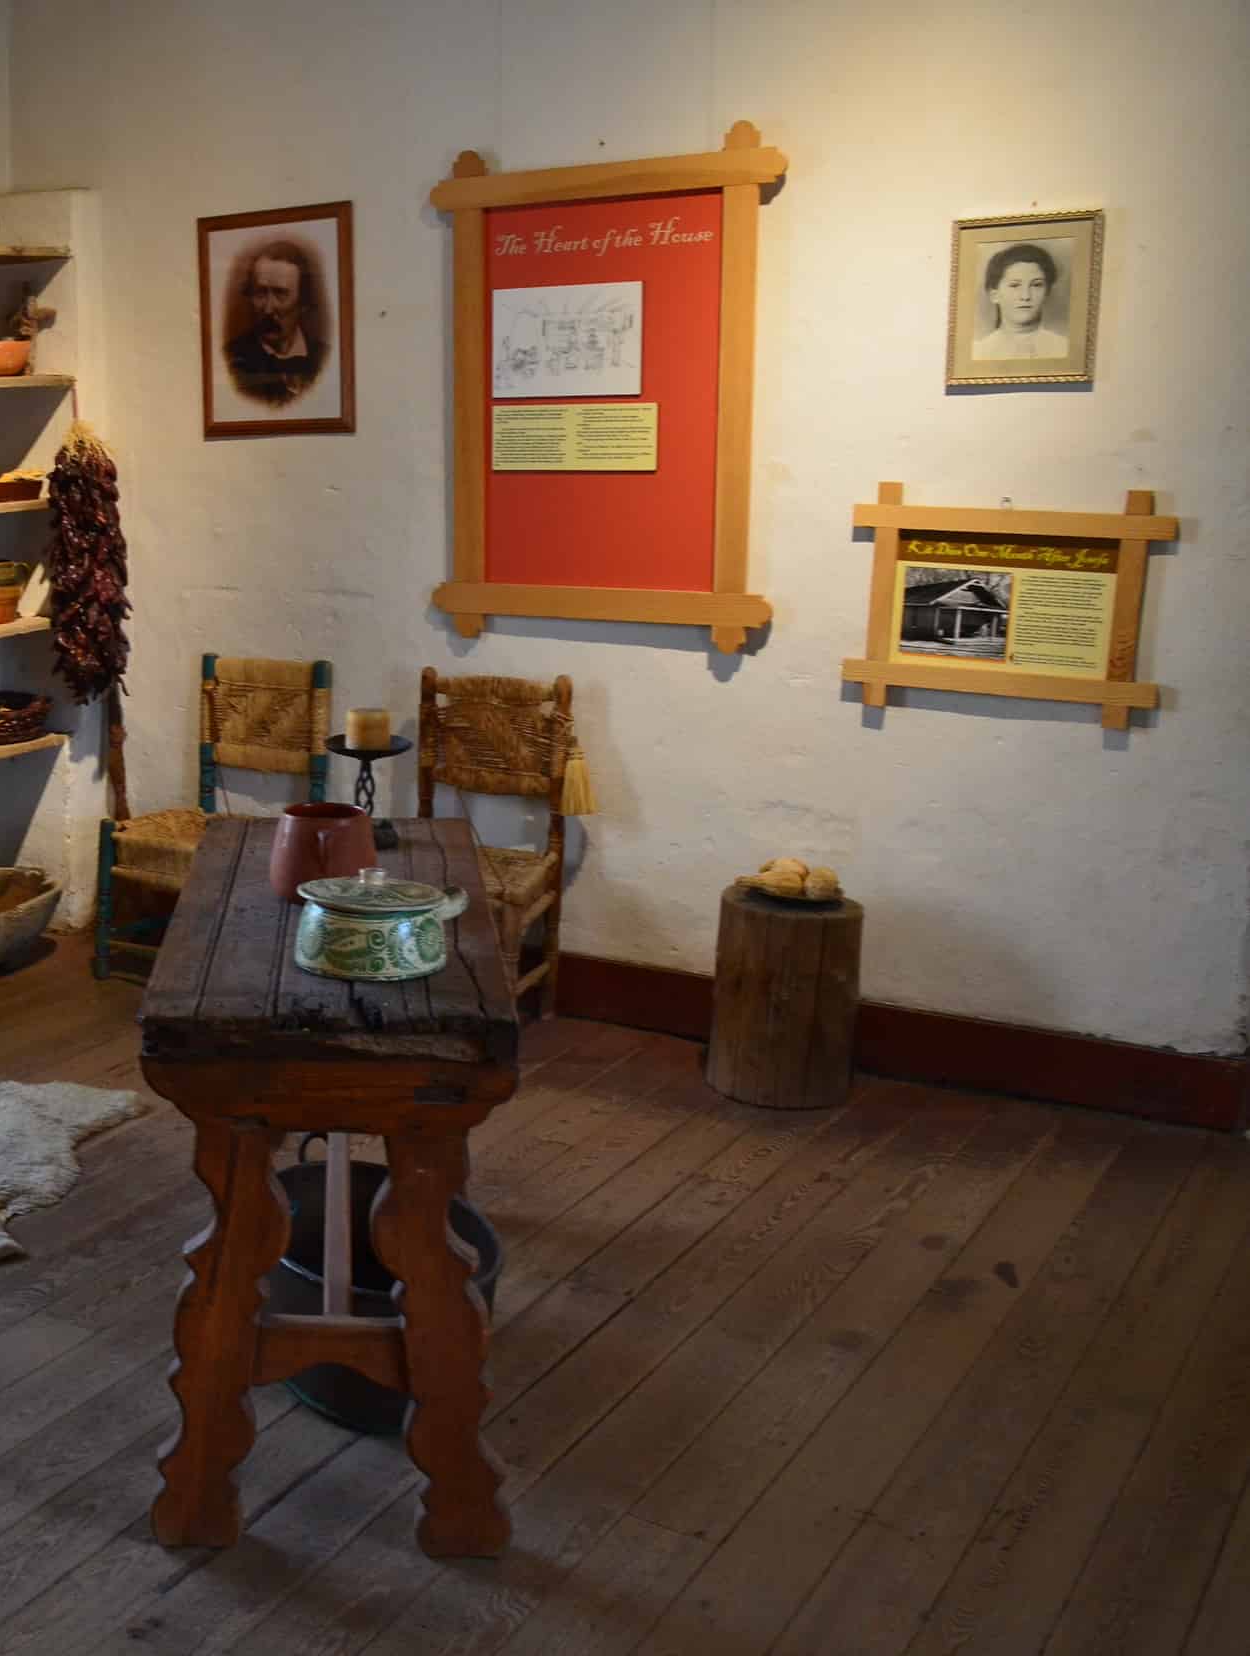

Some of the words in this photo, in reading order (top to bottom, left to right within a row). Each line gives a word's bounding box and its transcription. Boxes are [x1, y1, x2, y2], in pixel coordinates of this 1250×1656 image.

[495, 234, 526, 256] The
[533, 226, 590, 253] Heart
[592, 229, 615, 256] of
[615, 229, 642, 247] the
[648, 216, 714, 246] House
